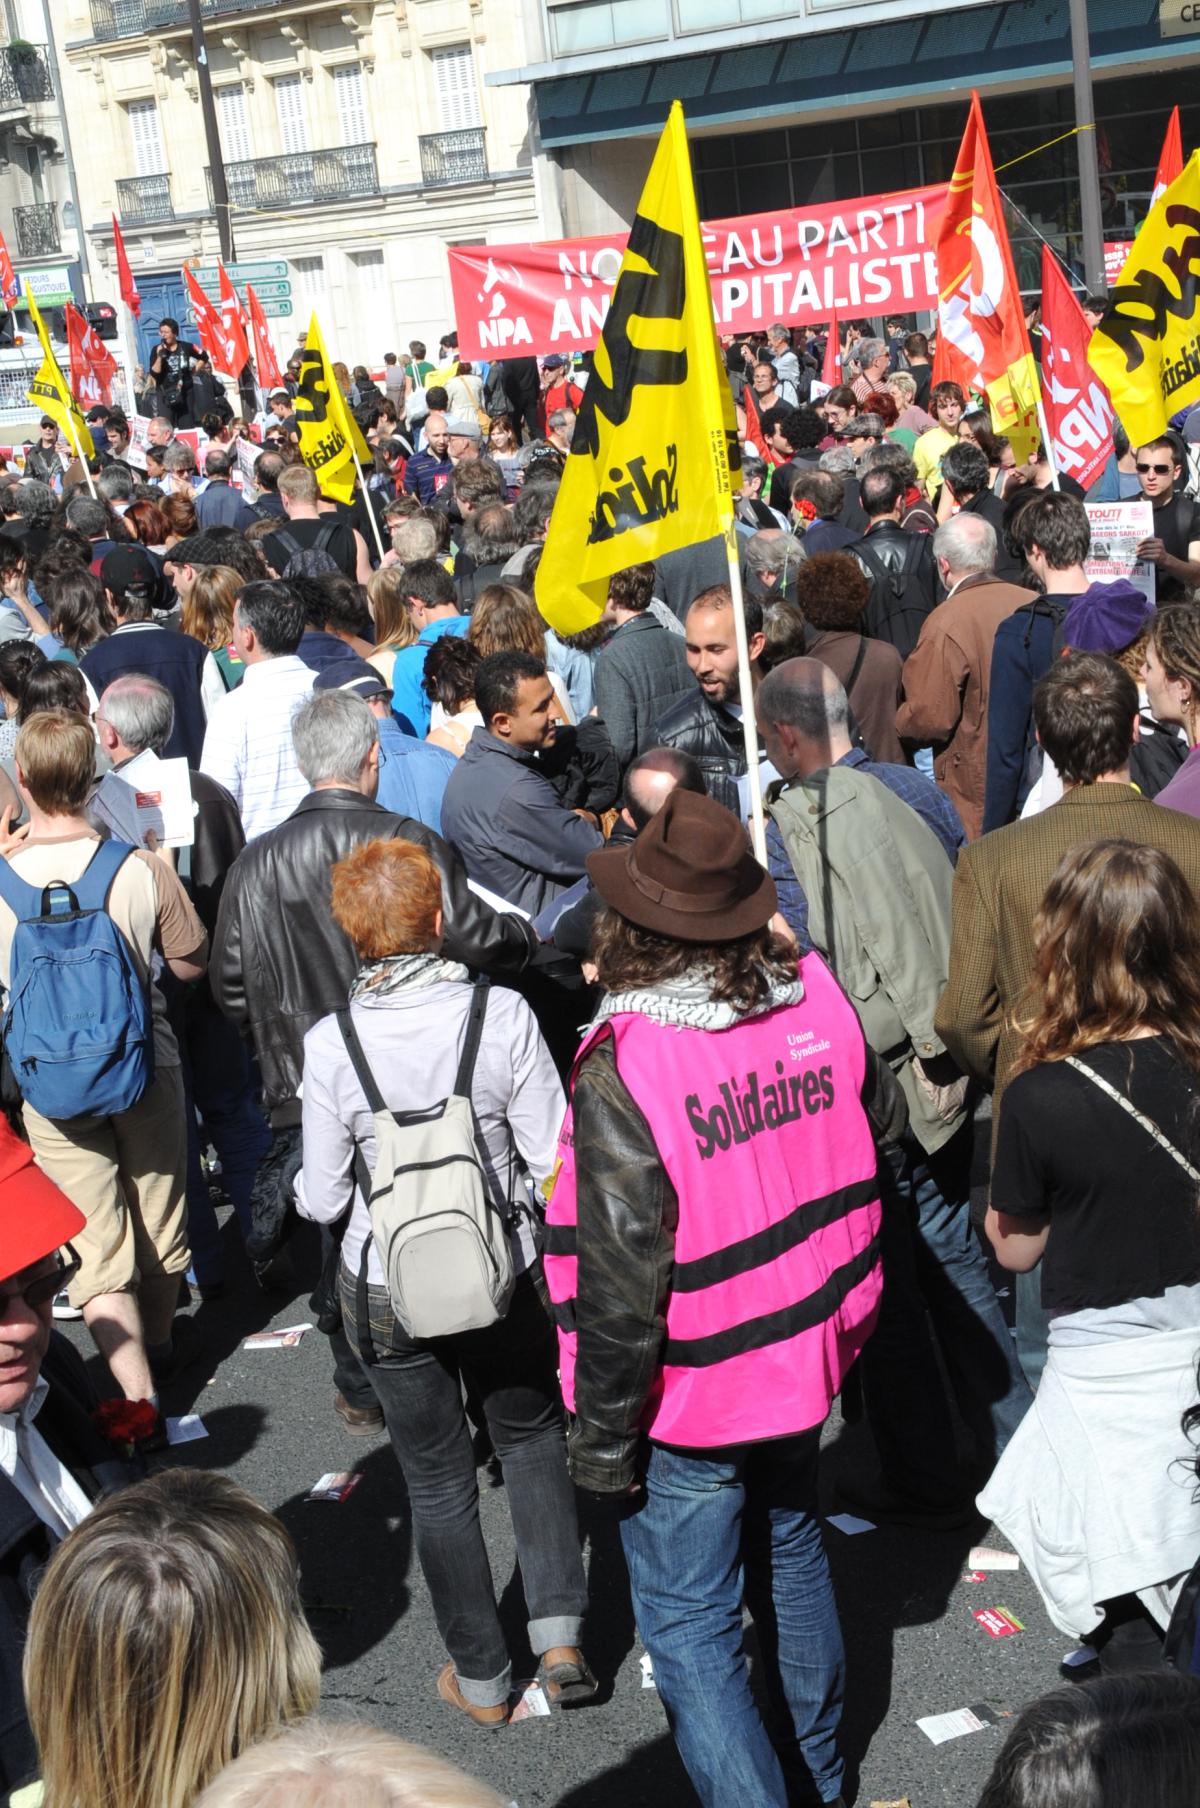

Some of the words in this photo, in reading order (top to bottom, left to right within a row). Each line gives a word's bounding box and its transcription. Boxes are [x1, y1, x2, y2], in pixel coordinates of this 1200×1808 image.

[558, 225, 783, 290] NOEAU
[798, 202, 924, 261] PARTI
[550, 252, 939, 342] ANPITALISTE
[478, 316, 533, 348] NPA
[786, 1030, 815, 1047] Union
[790, 1039, 831, 1061] Syndicale
[685, 1060, 835, 1161] Solidaires
